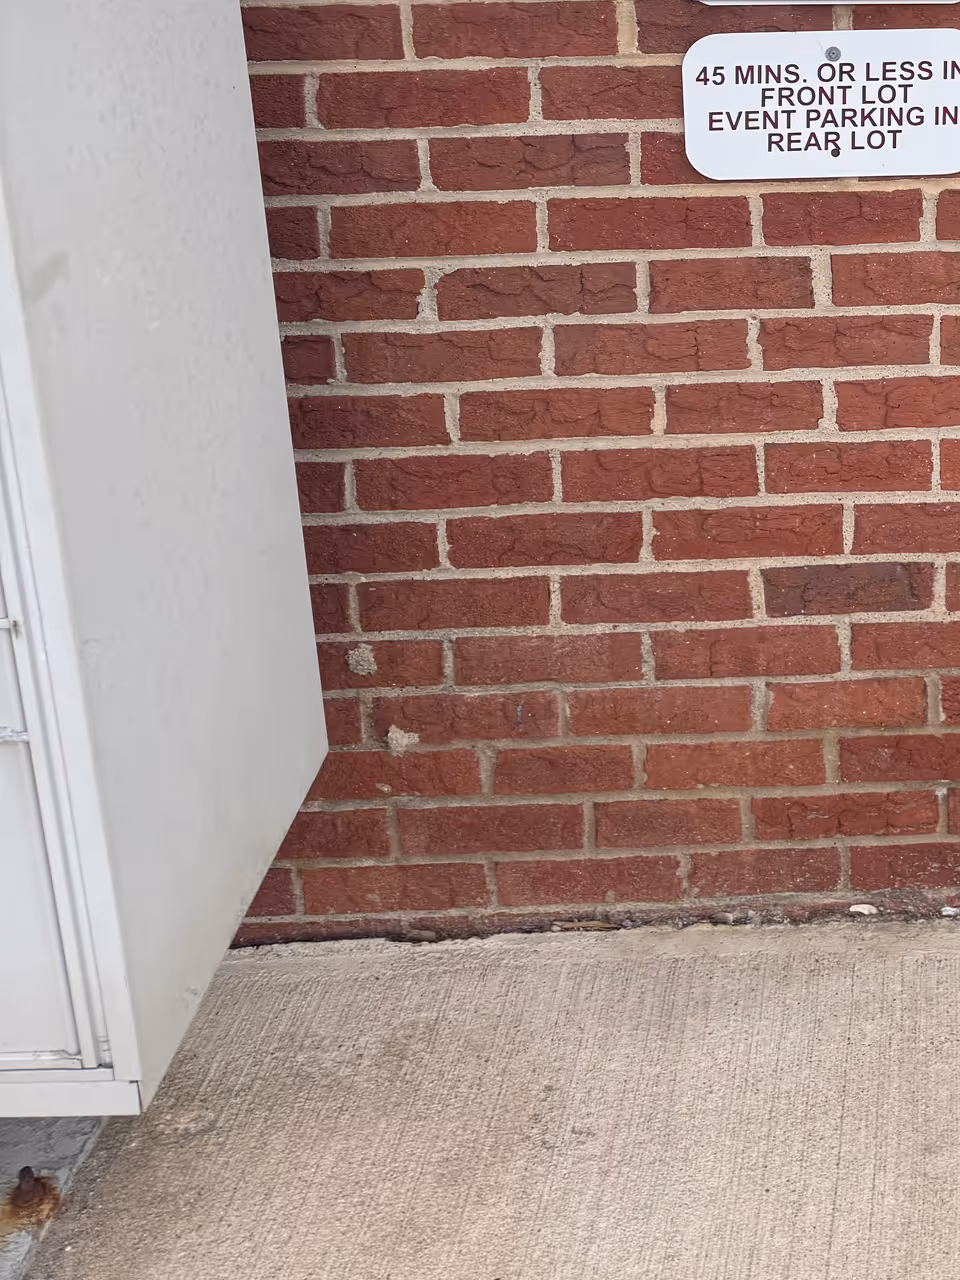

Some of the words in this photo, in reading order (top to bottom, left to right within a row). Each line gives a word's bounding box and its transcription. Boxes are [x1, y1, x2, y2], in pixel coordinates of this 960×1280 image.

[695, 66, 726, 86] 45
[735, 63, 807, 85] MINS.
[817, 62, 856, 82] OR
[865, 60, 933, 82] LESS
[761, 86, 852, 108] FRONT
[861, 84, 913, 105] LOT
[708, 110, 797, 131] EVENT
[805, 107, 925, 129] PARKING
[934, 106, 959, 126] IN
[767, 131, 842, 152] REAR
[851, 130, 903, 150] LOT
